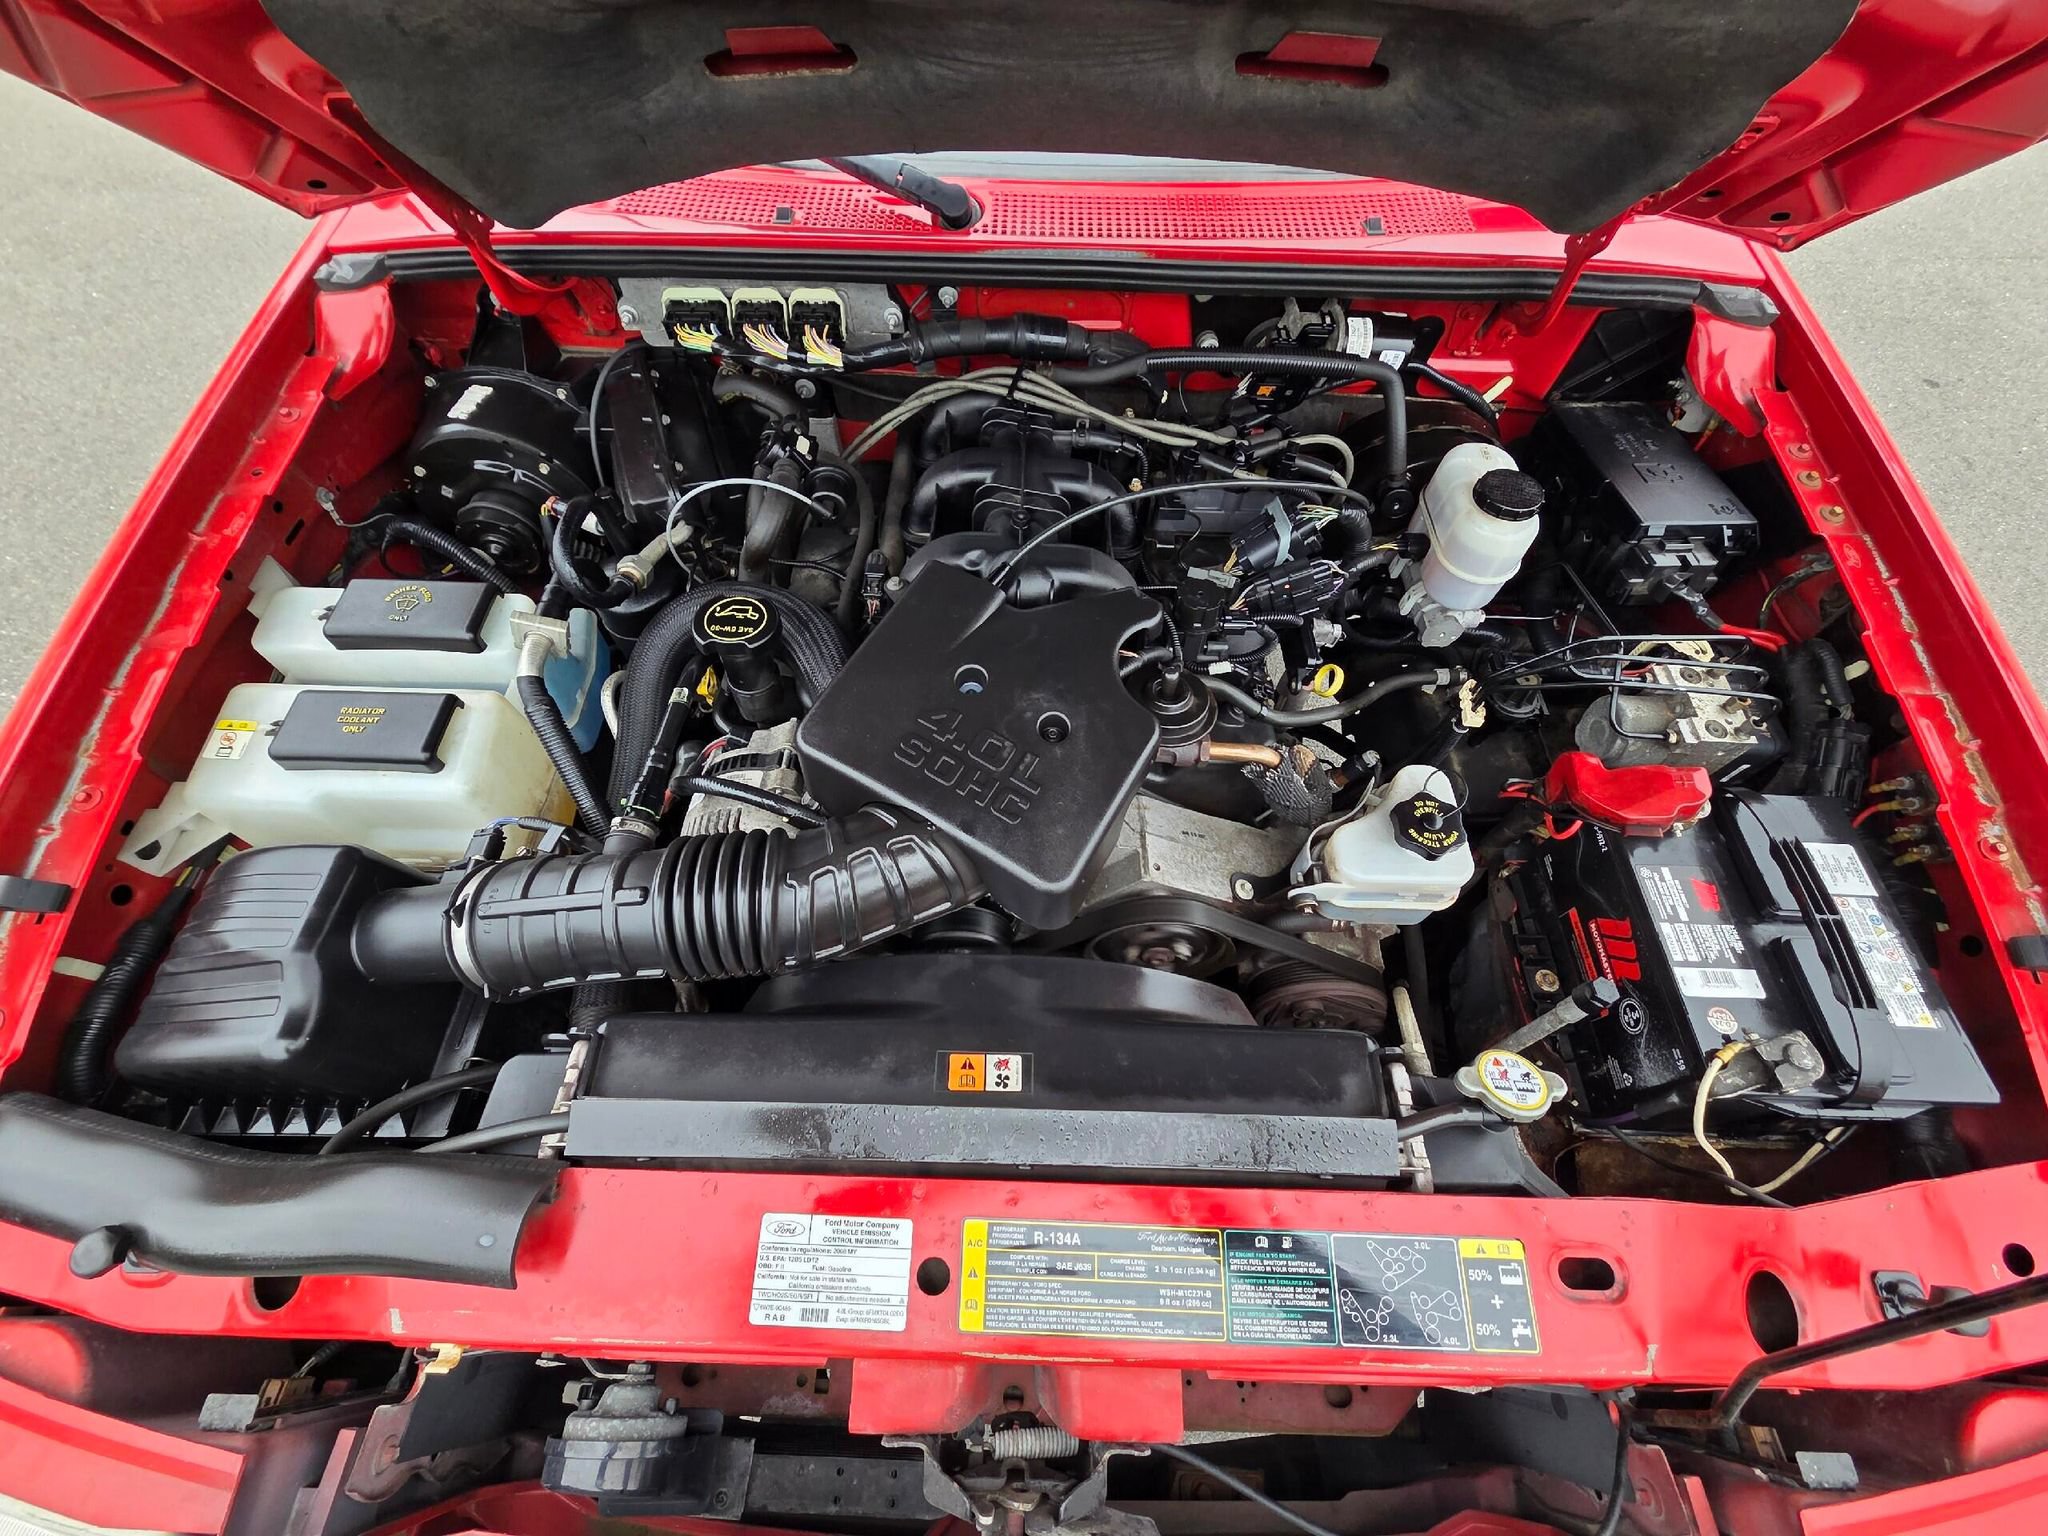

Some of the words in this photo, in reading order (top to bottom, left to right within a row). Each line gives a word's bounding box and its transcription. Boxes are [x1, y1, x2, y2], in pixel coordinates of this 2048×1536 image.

[340, 707, 386, 715] RADIATOR
[336, 716, 381, 724] COOLANT
[342, 725, 366, 734] ONLY
[917, 709, 1041, 795] 4.0L
[893, 733, 1031, 825] SOHC
[1423, 832, 1447, 841] FLUID
[774, 1223, 797, 1234] Ford
[825, 1219, 842, 1227] Ford
[844, 1220, 864, 1228] Motor
[866, 1221, 900, 1230] Company
[855, 1238, 899, 1246] INFORMATION
[1034, 1231, 1081, 1246] R-134A
[968, 1239, 983, 1248] A/C
[1414, 1241, 1431, 1250] 3.0L
[1056, 1262, 1073, 1270] SAE
[1074, 1262, 1092, 1271] J639
[1468, 1268, 1493, 1282] 50%
[1475, 1323, 1501, 1336] 50%
[1382, 1334, 1400, 1343] 2.3L
[1443, 1336, 1461, 1345] 4.0L
